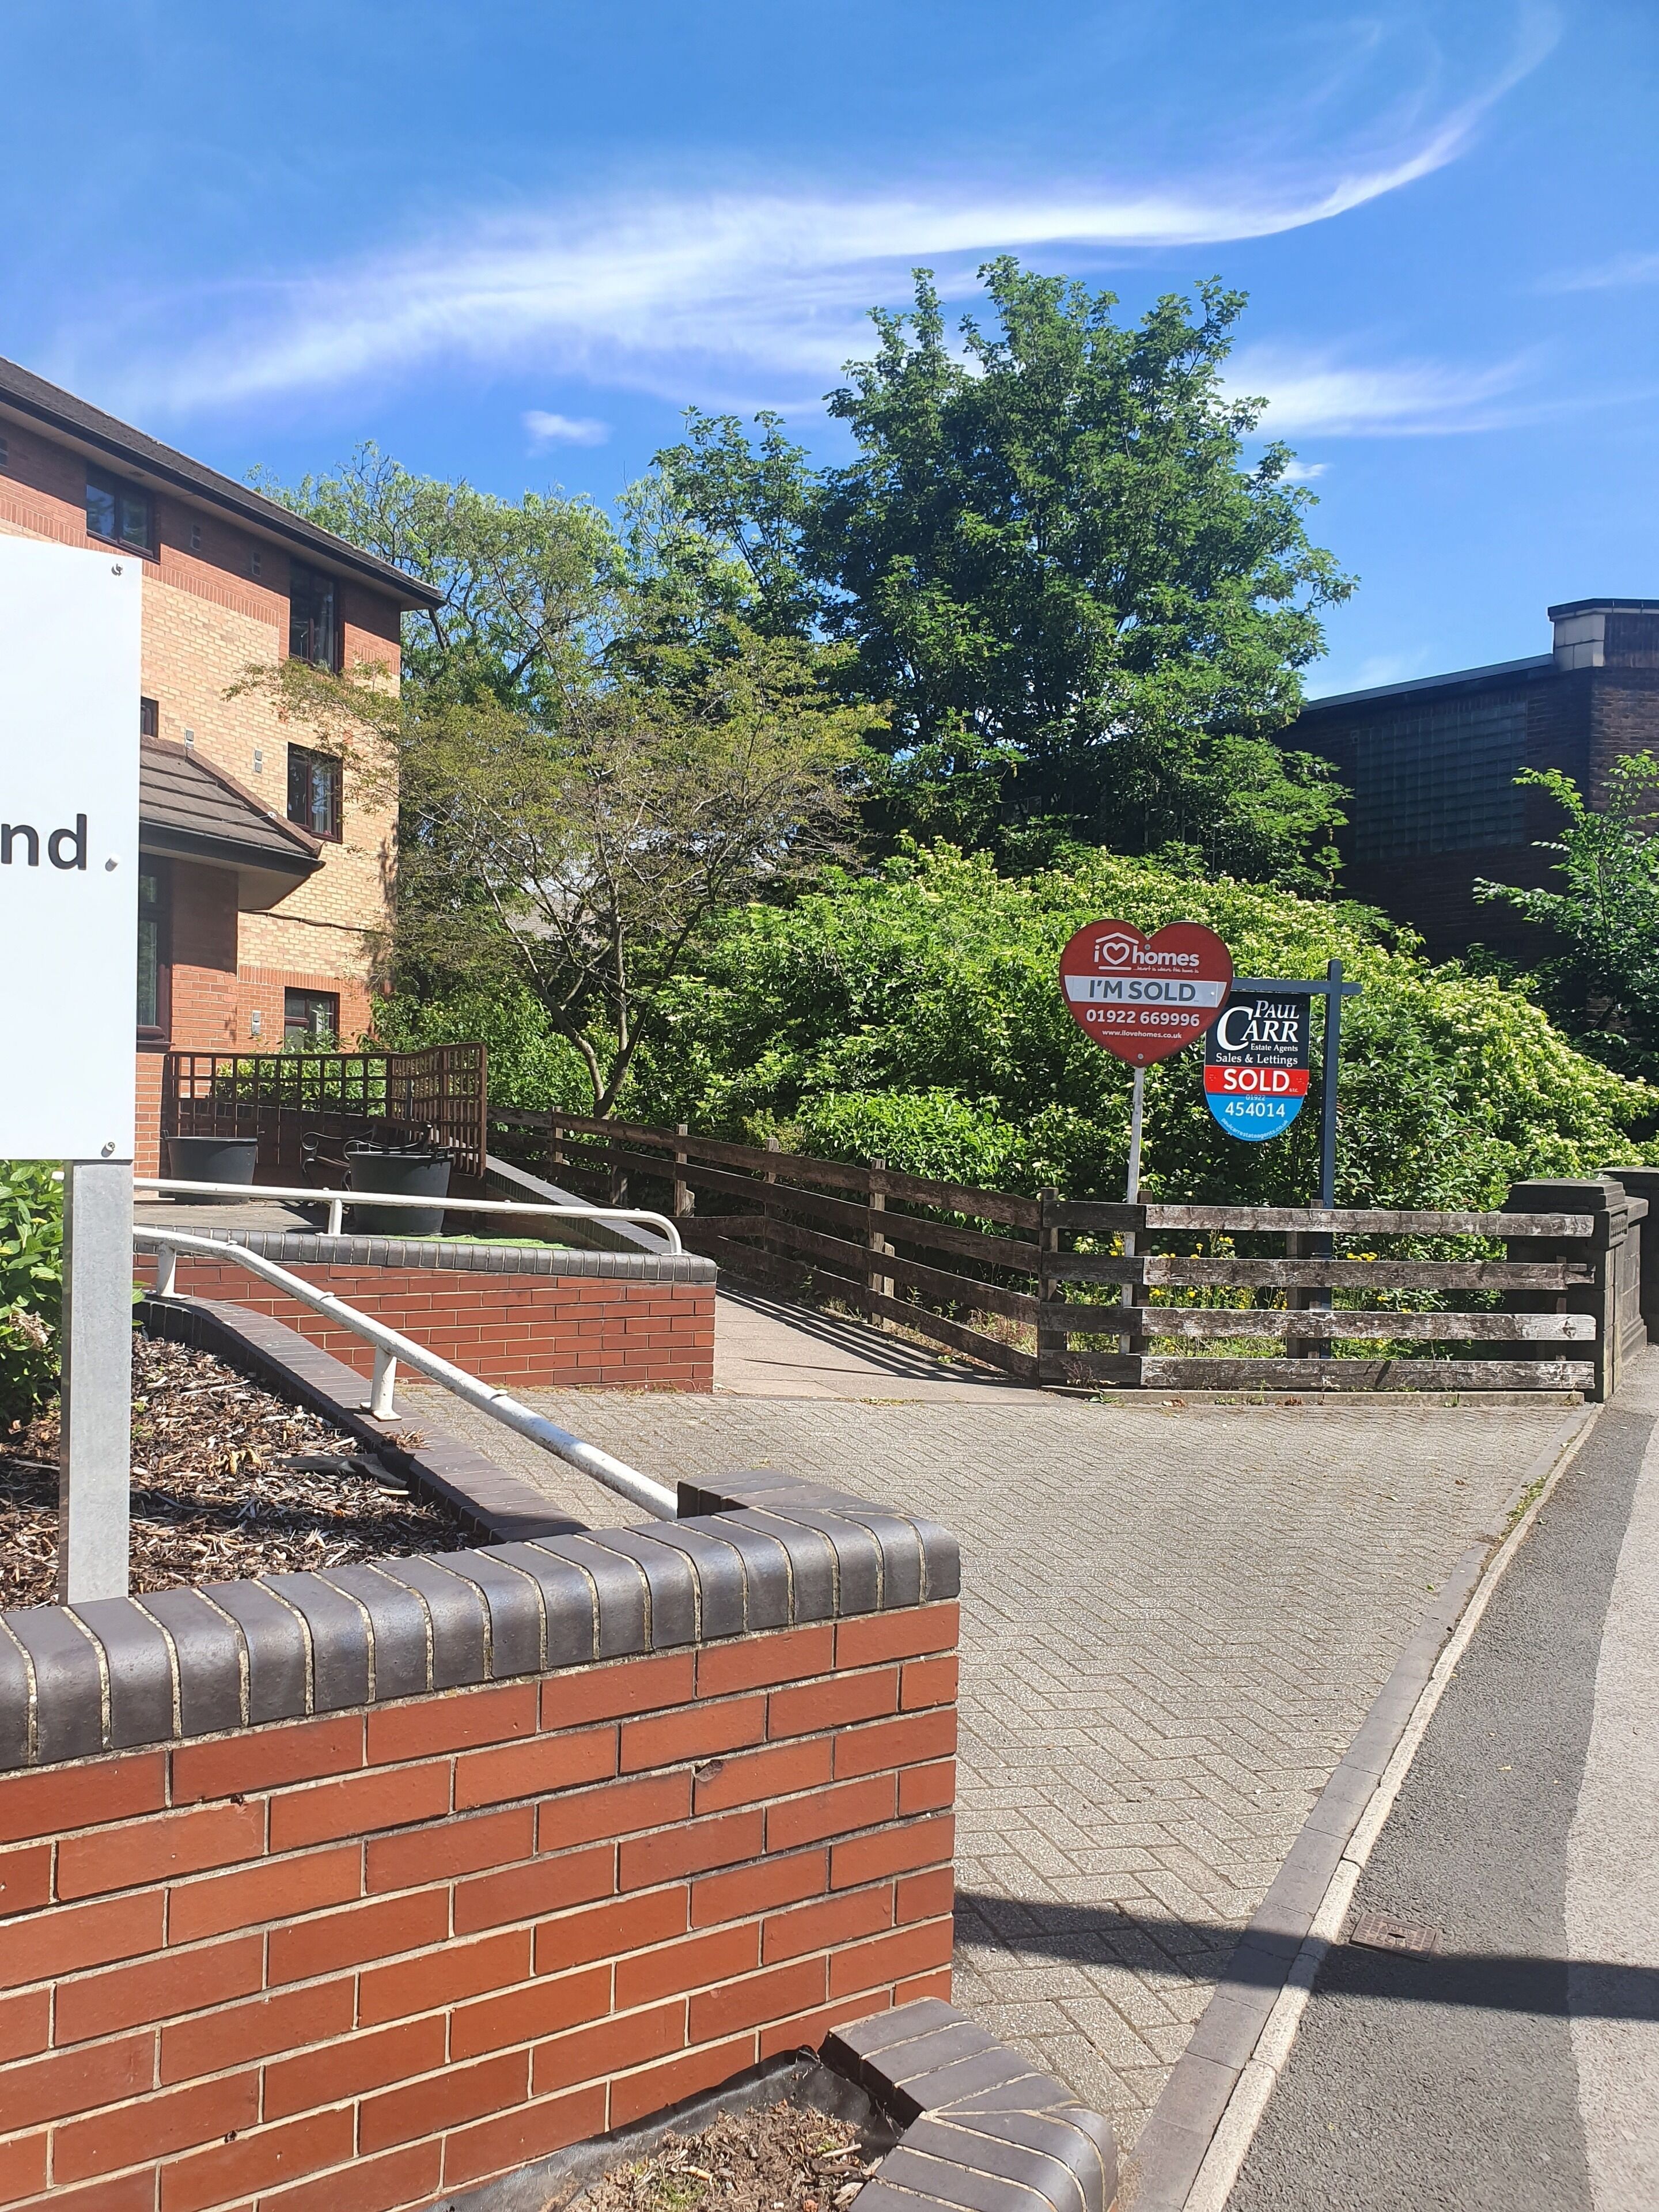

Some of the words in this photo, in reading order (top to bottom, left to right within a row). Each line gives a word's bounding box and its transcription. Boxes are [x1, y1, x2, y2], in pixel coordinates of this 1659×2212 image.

[1132, 945, 1200, 967] homes
[1089, 980, 1123, 999] I'M
[1127, 981, 1196, 1002] SOLD
[1086, 1009, 1136, 1023] 01922
[1140, 1012, 1200, 1027] 669996
[1253, 1000, 1300, 1019] PAUL
[1102, 1029, 1182, 1039] www.ilovehomes.co.uk
[1217, 1006, 1298, 1051] CARR
[1273, 1044, 1298, 1053] Agents
[1216, 1052, 1242, 1063] Sales
[1244, 1053, 1253, 1063] &
[1257, 1054, 1298, 1067] Lettings
[1223, 1068, 1290, 1092] SOLD
[1225, 1101, 1285, 1118] 454014
[1220, 1118, 1289, 1139] paulcarrestateagents.co.uk
